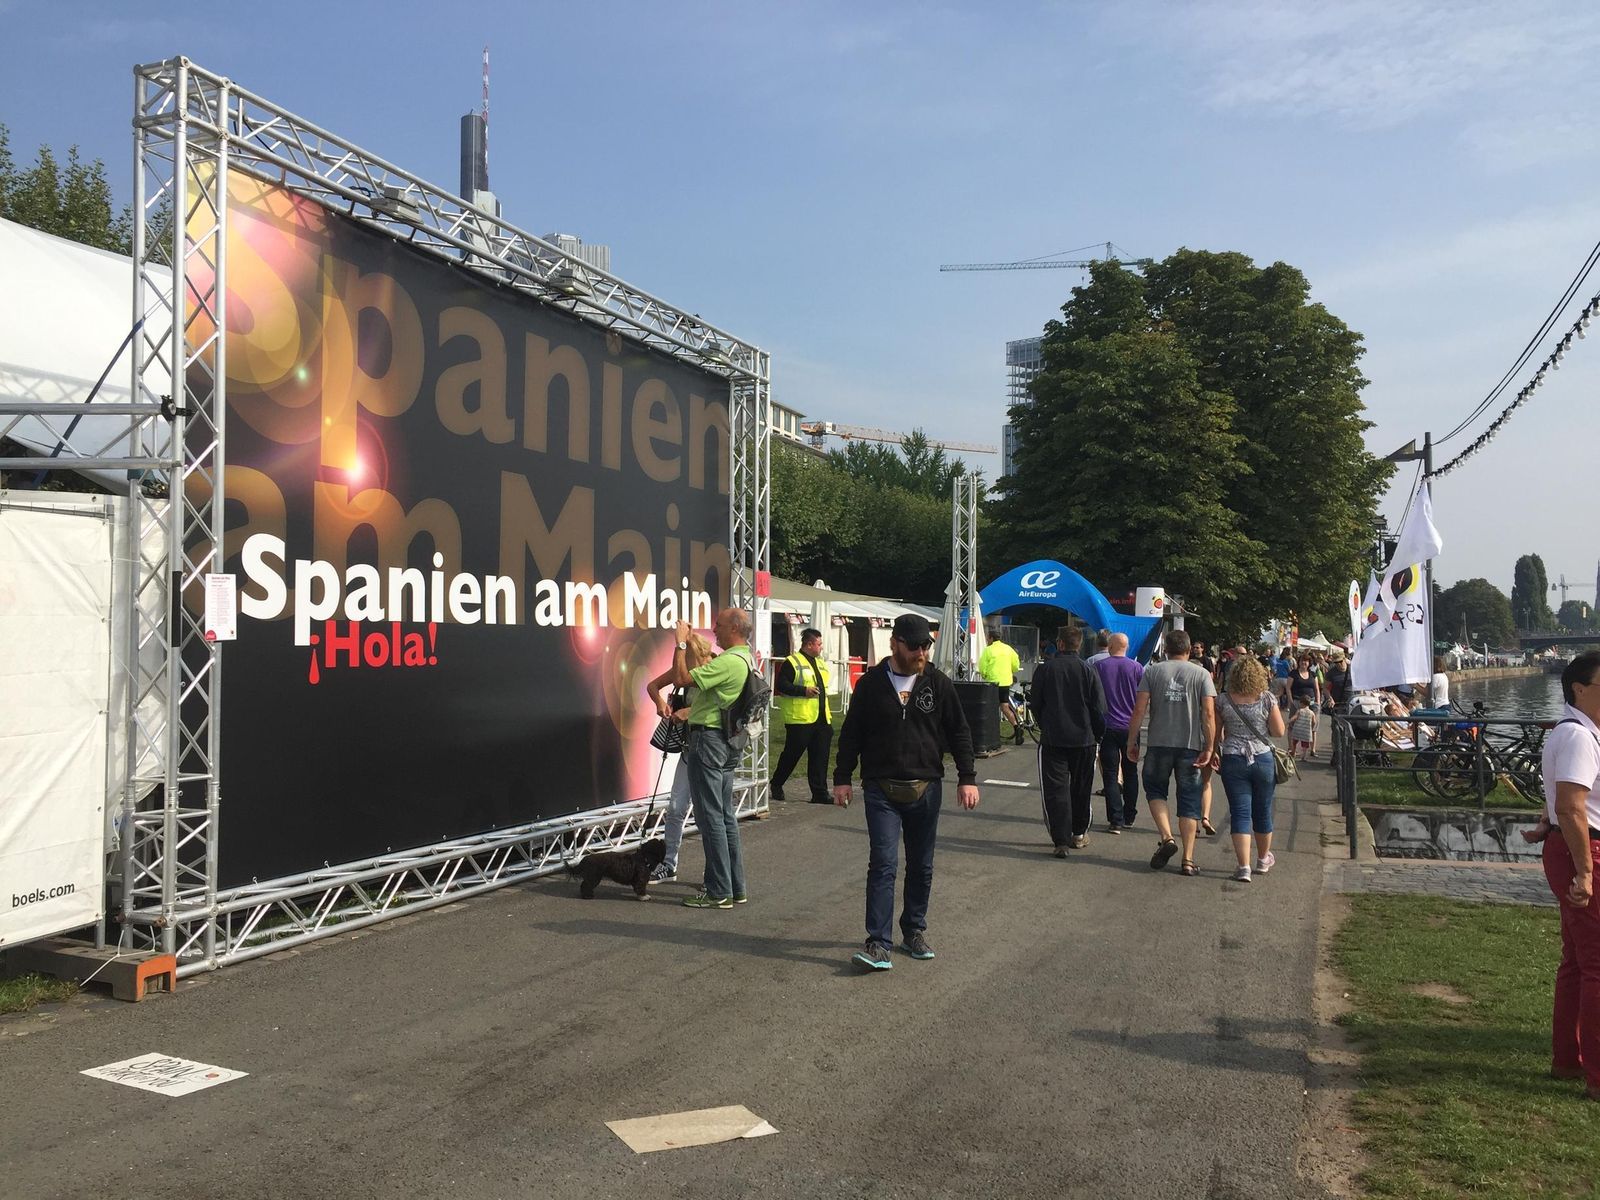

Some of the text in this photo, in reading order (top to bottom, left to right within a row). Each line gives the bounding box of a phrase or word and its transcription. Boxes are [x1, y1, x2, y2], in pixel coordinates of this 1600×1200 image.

[241, 533, 517, 646] Spanien
[534, 578, 608, 628] am
[623, 571, 712, 629] Main
[1018, 591, 1057, 599] AirEuropa
[12, 883, 75, 908] boels.com
